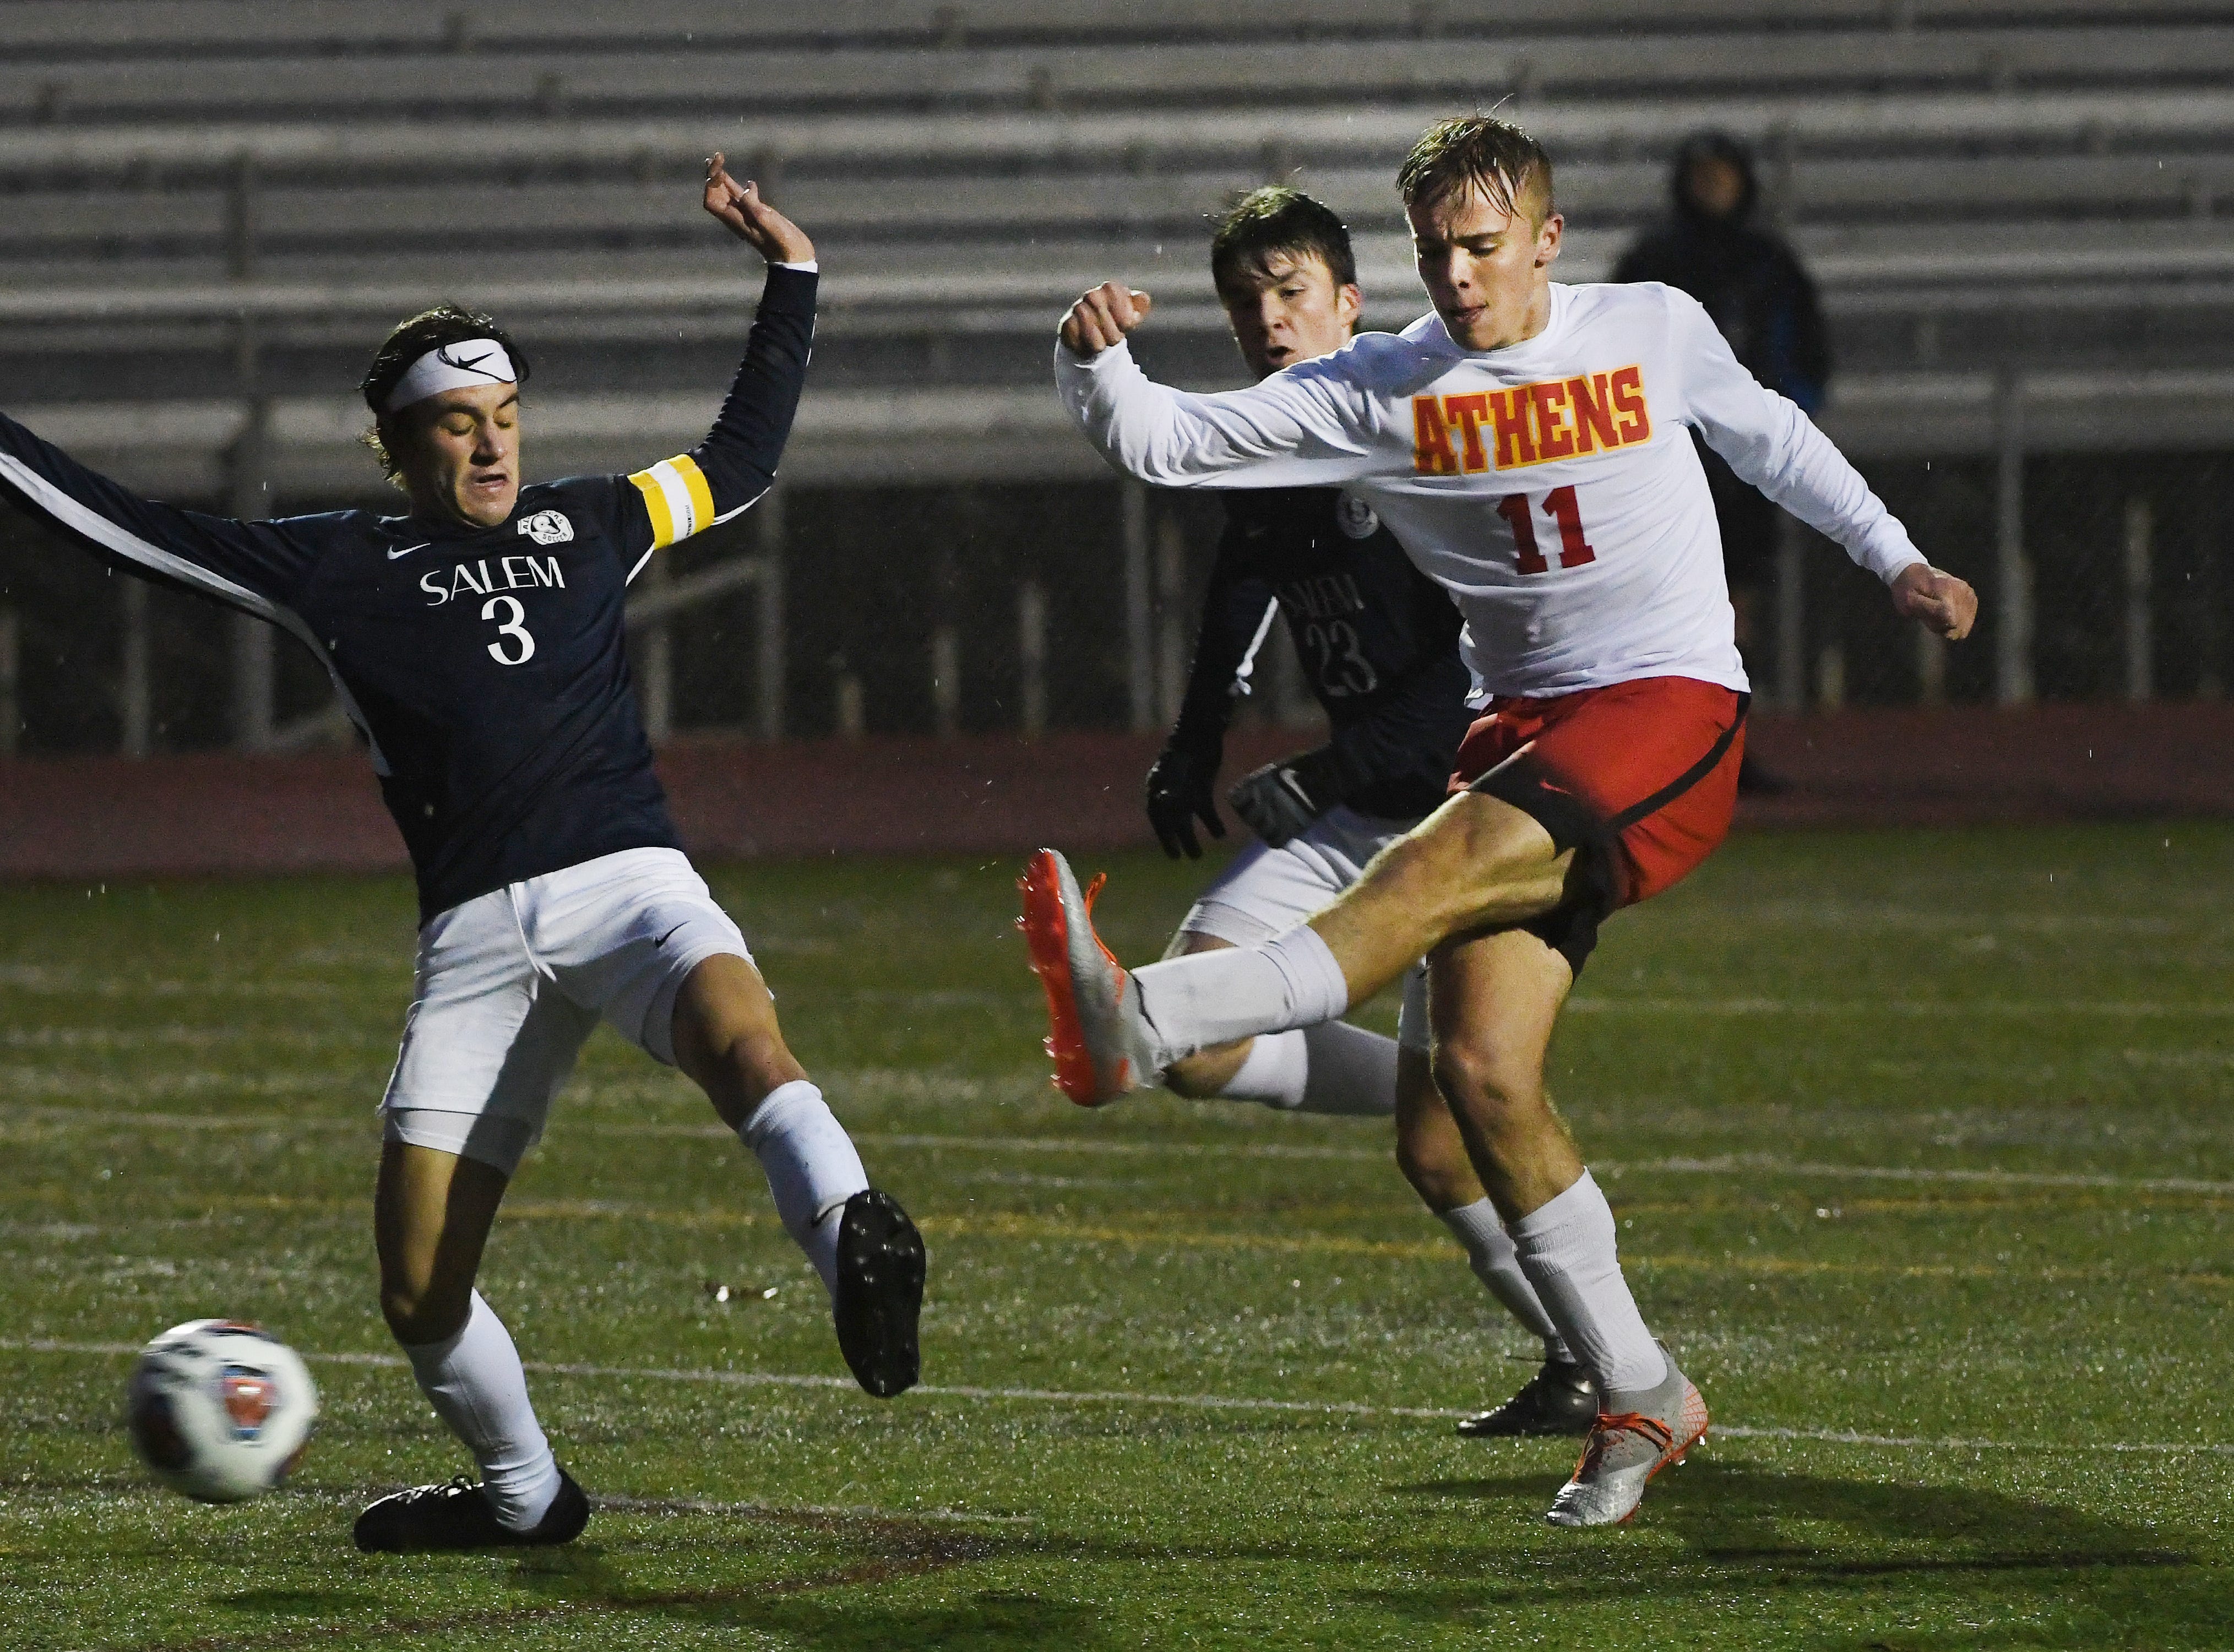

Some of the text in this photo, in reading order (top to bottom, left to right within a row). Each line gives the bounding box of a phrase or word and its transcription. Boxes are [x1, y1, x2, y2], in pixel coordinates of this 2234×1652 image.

[1413, 364, 1653, 476] ATHENS
[1497, 485, 1596, 575] 11
[420, 556, 566, 606] SALEM
[481, 595, 535, 665] 3
[1306, 619, 1378, 697] 23
